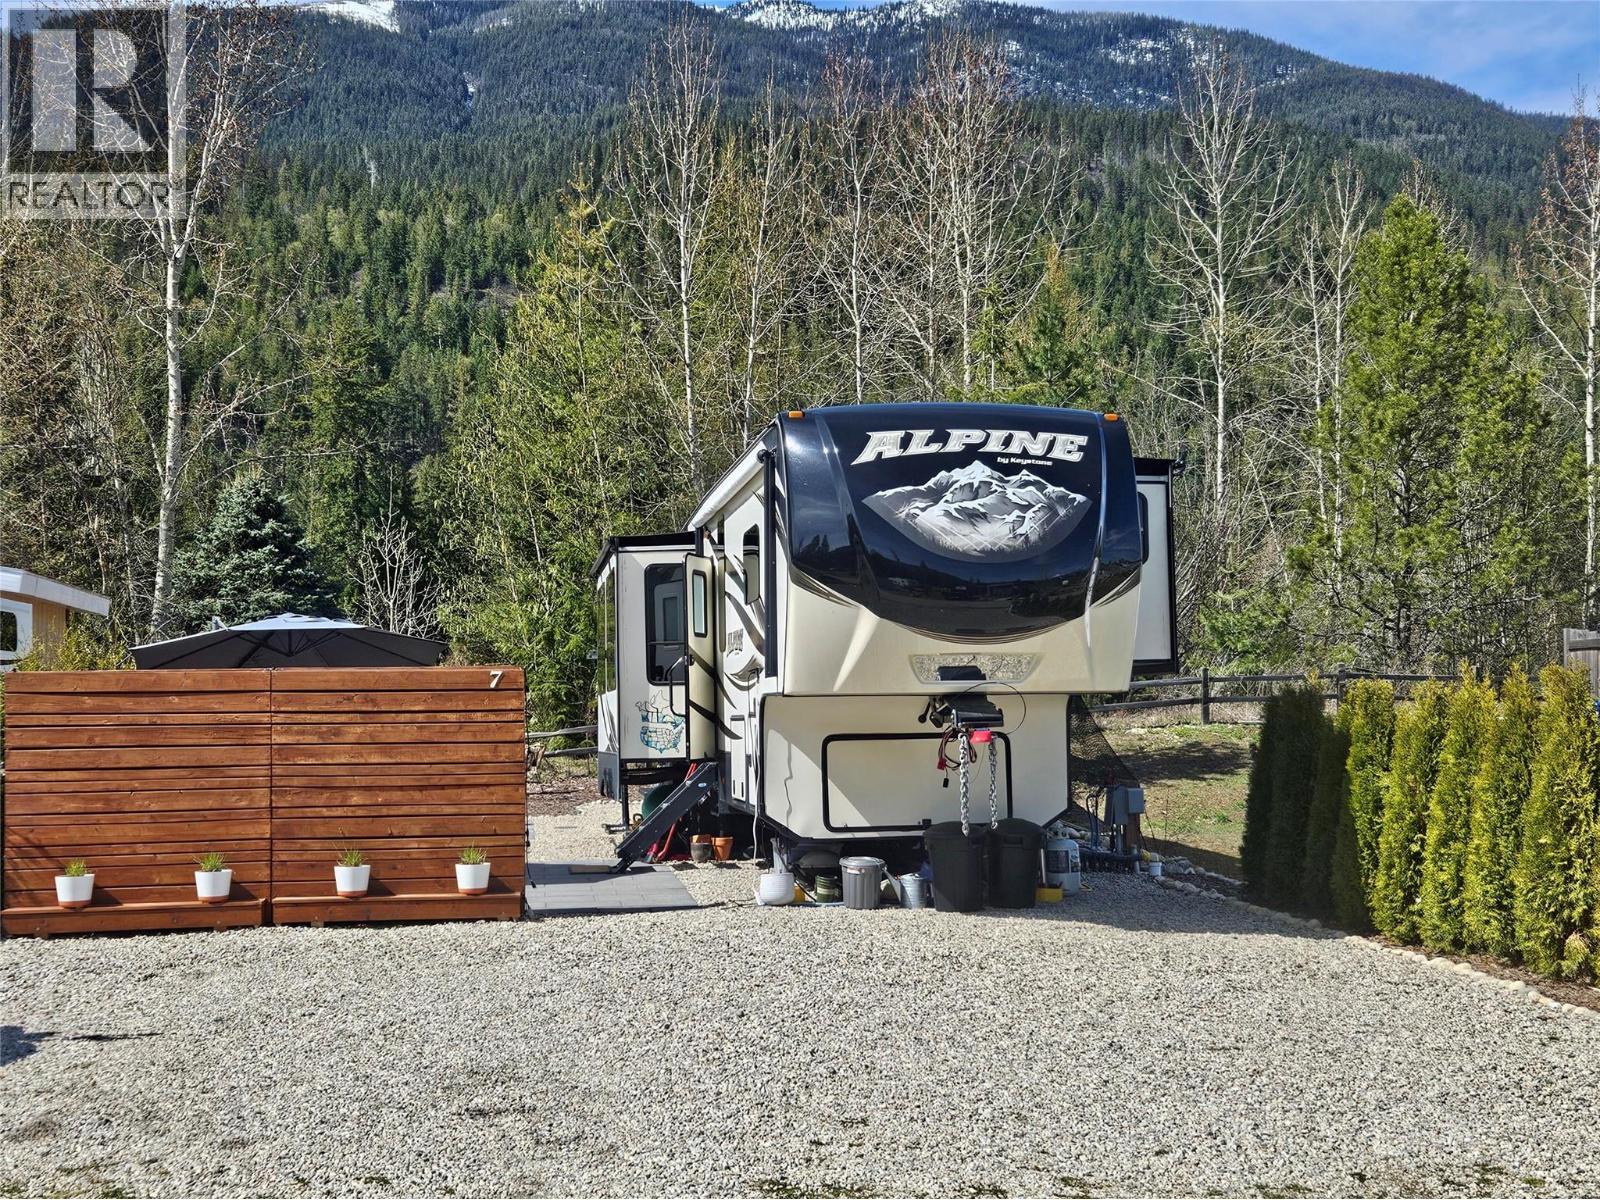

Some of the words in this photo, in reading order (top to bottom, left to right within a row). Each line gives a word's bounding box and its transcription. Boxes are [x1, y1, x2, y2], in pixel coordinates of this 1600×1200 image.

[851, 429, 1088, 465] ALPINE
[997, 456, 1009, 464] by
[1010, 457, 1053, 466] Keystone
[489, 670, 503, 689] 7
